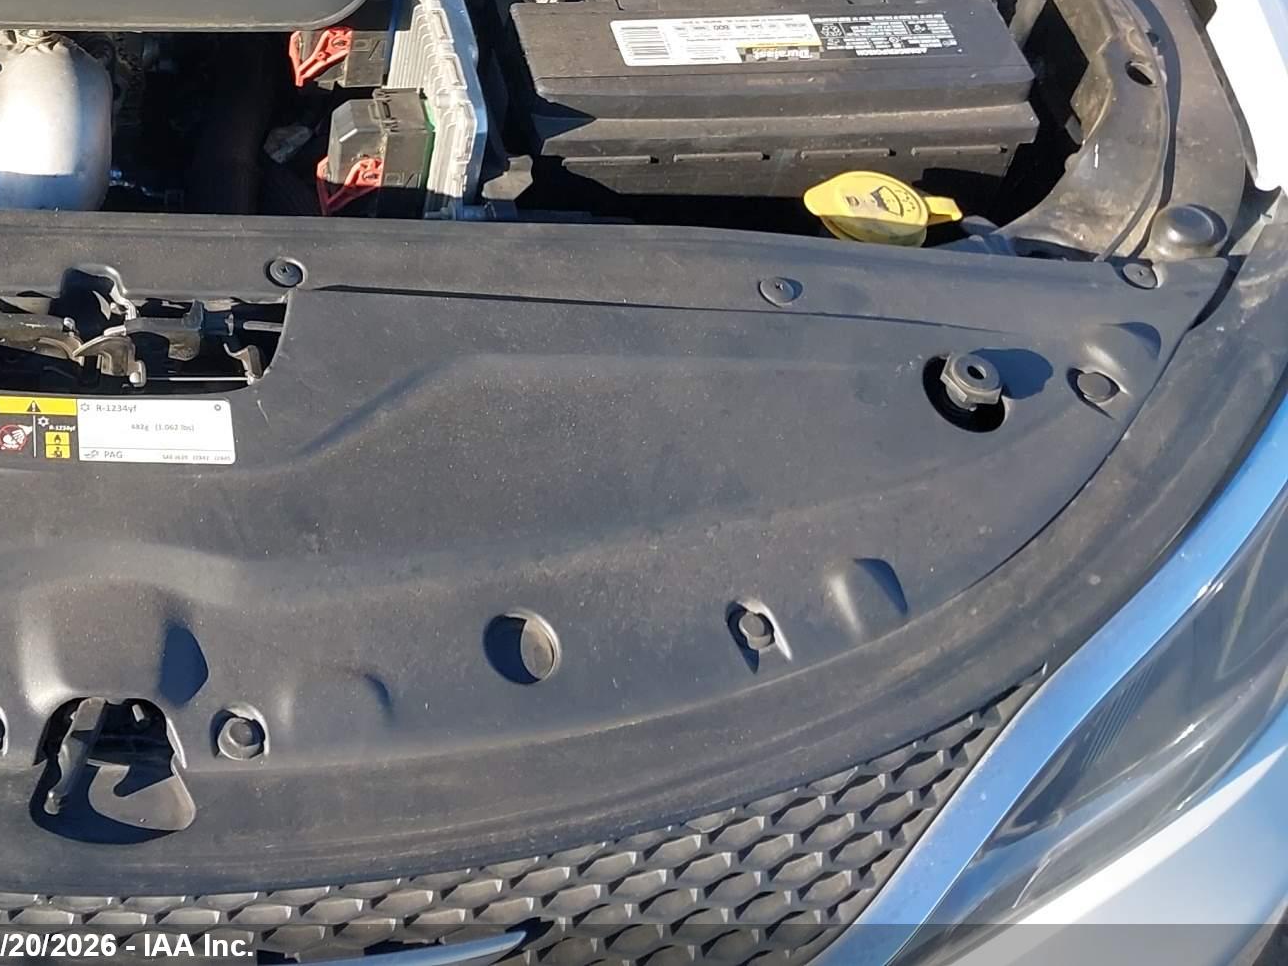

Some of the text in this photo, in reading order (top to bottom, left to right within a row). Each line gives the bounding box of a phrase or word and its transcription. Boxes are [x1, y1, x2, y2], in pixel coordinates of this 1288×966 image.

[752, 48, 813, 59] Duralast
[96, 404, 137, 413] R-1234yf
[104, 451, 123, 459] PAG
